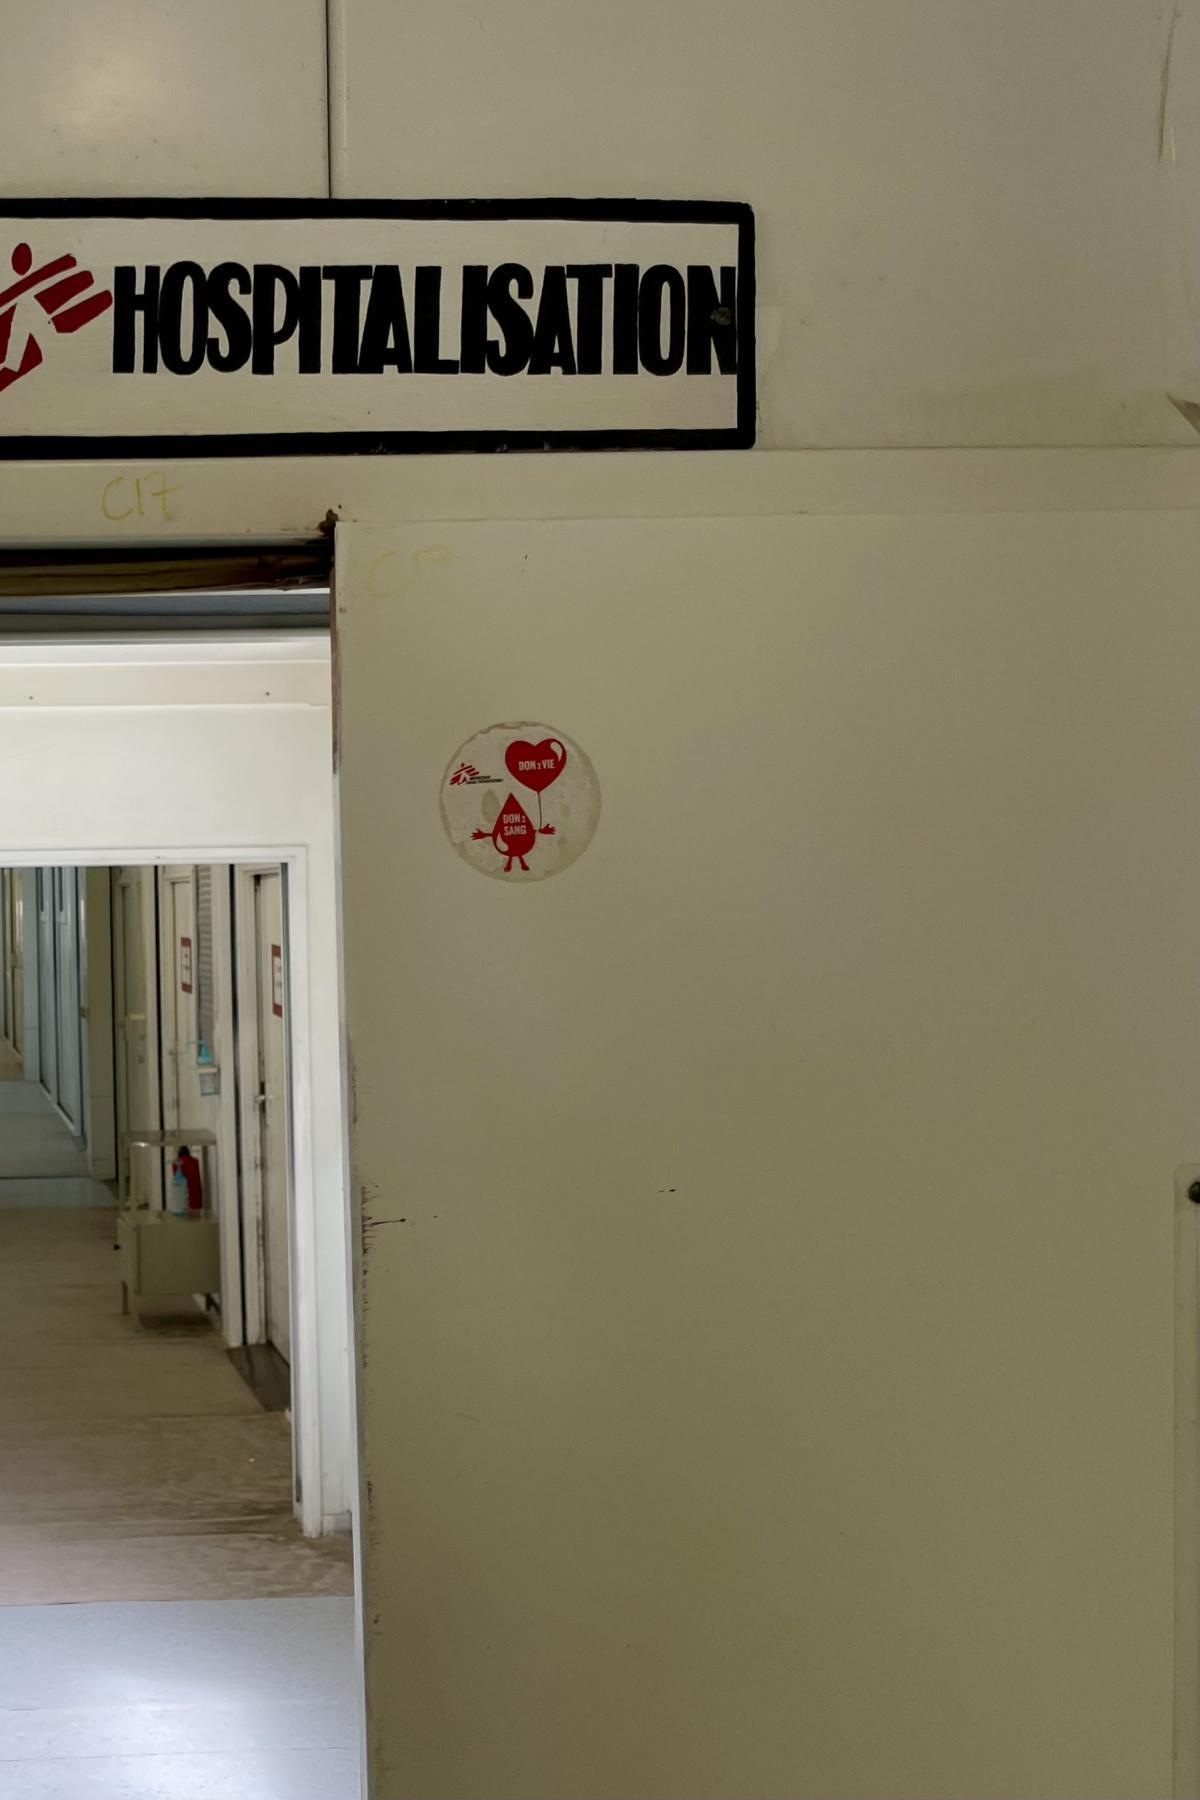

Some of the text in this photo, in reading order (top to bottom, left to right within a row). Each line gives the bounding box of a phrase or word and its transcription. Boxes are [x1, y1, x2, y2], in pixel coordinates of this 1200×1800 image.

[112, 260, 738, 377] HOSPITALISATION
[518, 760, 536, 771] DON
[542, 758, 555, 769] VIE
[503, 813, 520, 824] DON
[503, 825, 527, 836] SANG
